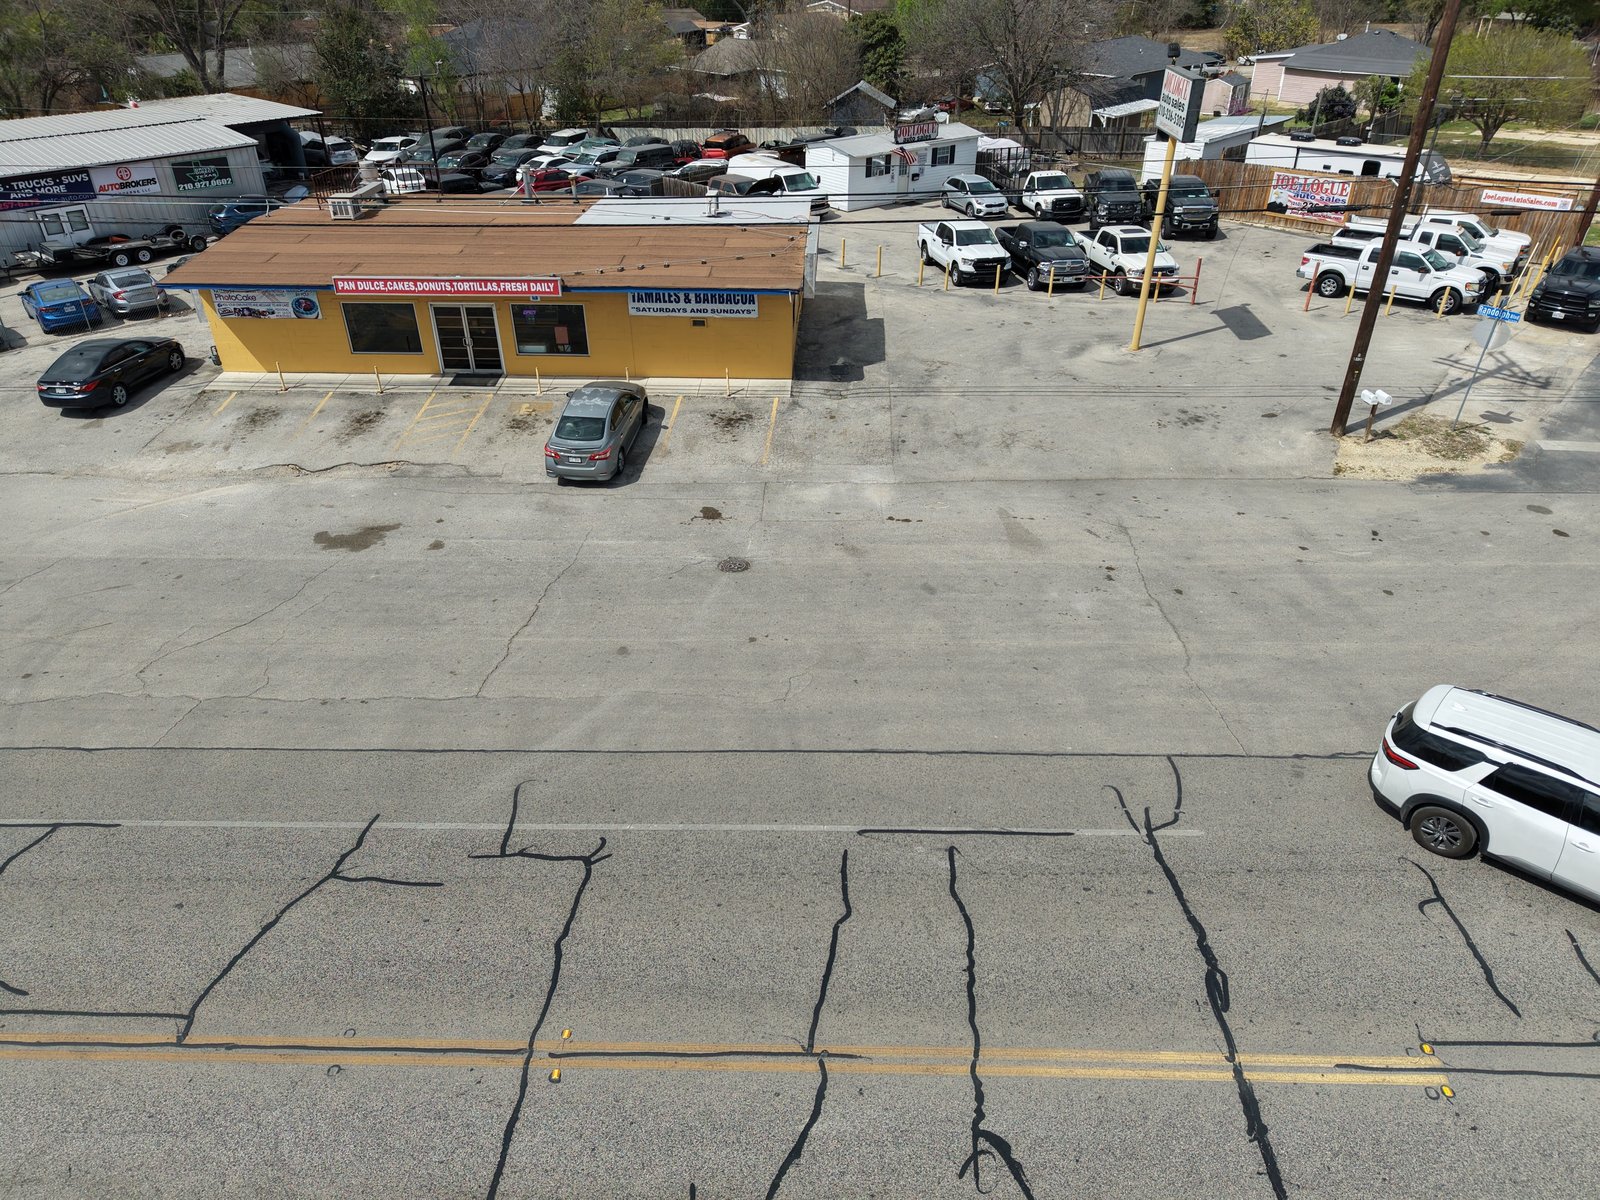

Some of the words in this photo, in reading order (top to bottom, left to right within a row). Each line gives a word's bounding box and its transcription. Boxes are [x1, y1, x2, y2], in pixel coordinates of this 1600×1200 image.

[1171, 98, 1185, 112] sales
[11, 178, 54, 190] TRUCKS
[61, 173, 89, 184] SUVS
[98, 178, 157, 192] AUTOBROKERS
[1272, 174, 1299, 190] JOE
[1301, 177, 1350, 197] LOGUE
[10, 189, 33, 199] AND
[35, 185, 67, 196] MORE
[1293, 192, 1316, 200] auto
[1320, 195, 1346, 204] sales
[337, 281, 355, 290] PAN
[530, 282, 554, 291] DAILY
[631, 292, 680, 304] TAMALES
[684, 293, 692, 304] &
[1479, 306, 1510, 319] Randolph
